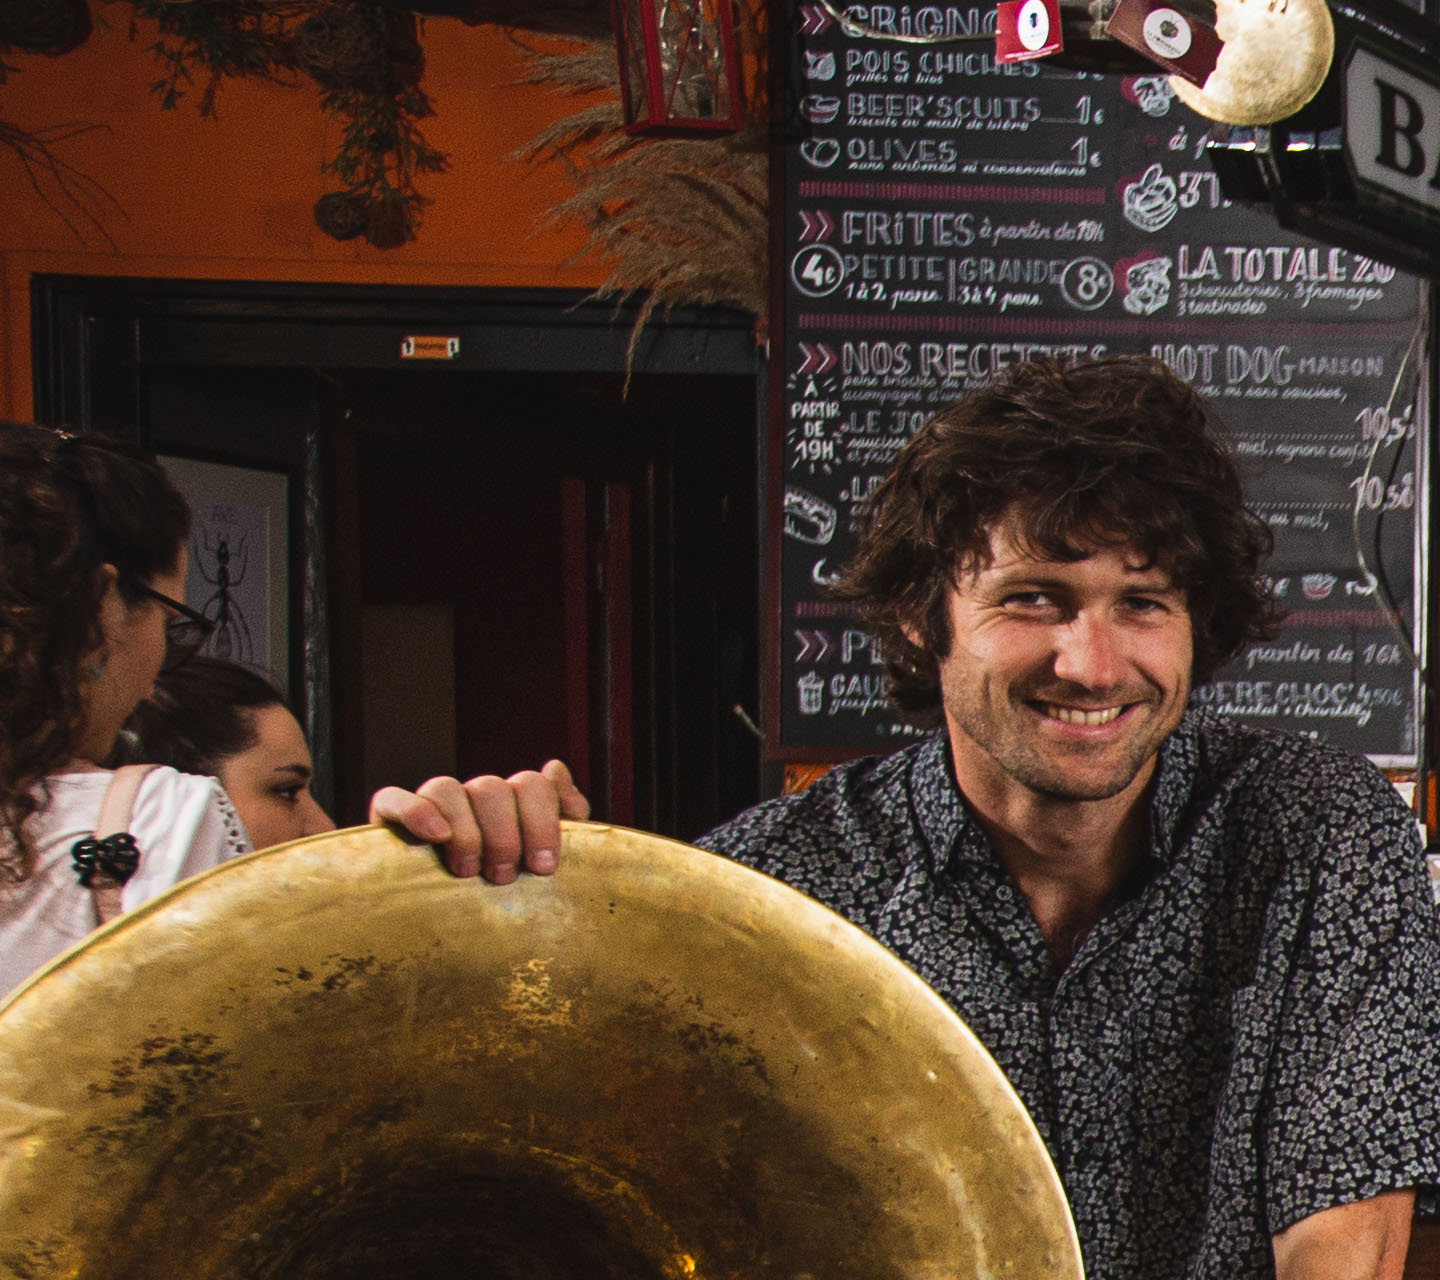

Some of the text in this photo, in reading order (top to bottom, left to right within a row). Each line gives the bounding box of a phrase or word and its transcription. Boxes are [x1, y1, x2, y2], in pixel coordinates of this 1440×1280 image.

[846, 50, 909, 74] POIS
[848, 93, 1041, 121] BEER'SCUITS
[848, 138, 958, 162] OLIVES
[843, 255, 945, 280] PETITE
[957, 257, 1066, 284] GRANDE
[1178, 245, 1347, 282] LA TOTALE
[842, 341, 911, 377] NOS
[1226, 345, 1296, 385] DOG
[1300, 356, 1384, 376] MAISON
[791, 401, 840, 419] PARTIR
[804, 420, 824, 438] DE
[796, 440, 835, 461] 19H
[1327, 644, 1354, 664] de
